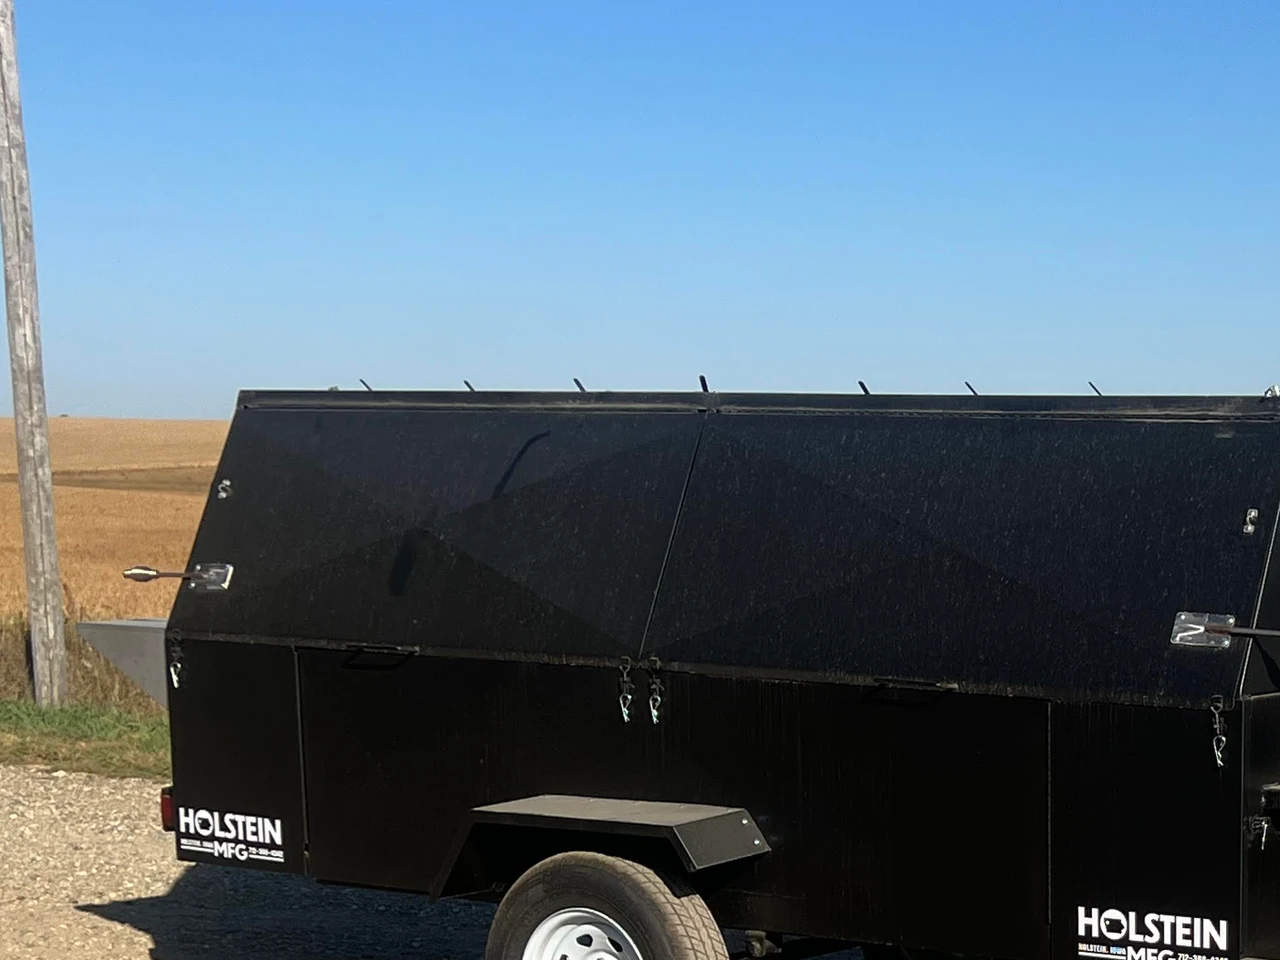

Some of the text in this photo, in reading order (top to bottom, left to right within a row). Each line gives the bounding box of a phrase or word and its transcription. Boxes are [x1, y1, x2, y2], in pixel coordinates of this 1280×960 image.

[179, 807, 282, 845] HOLSTEIN
[213, 841, 248, 861] MFG
[1077, 906, 1228, 950] HOLSTEIN
